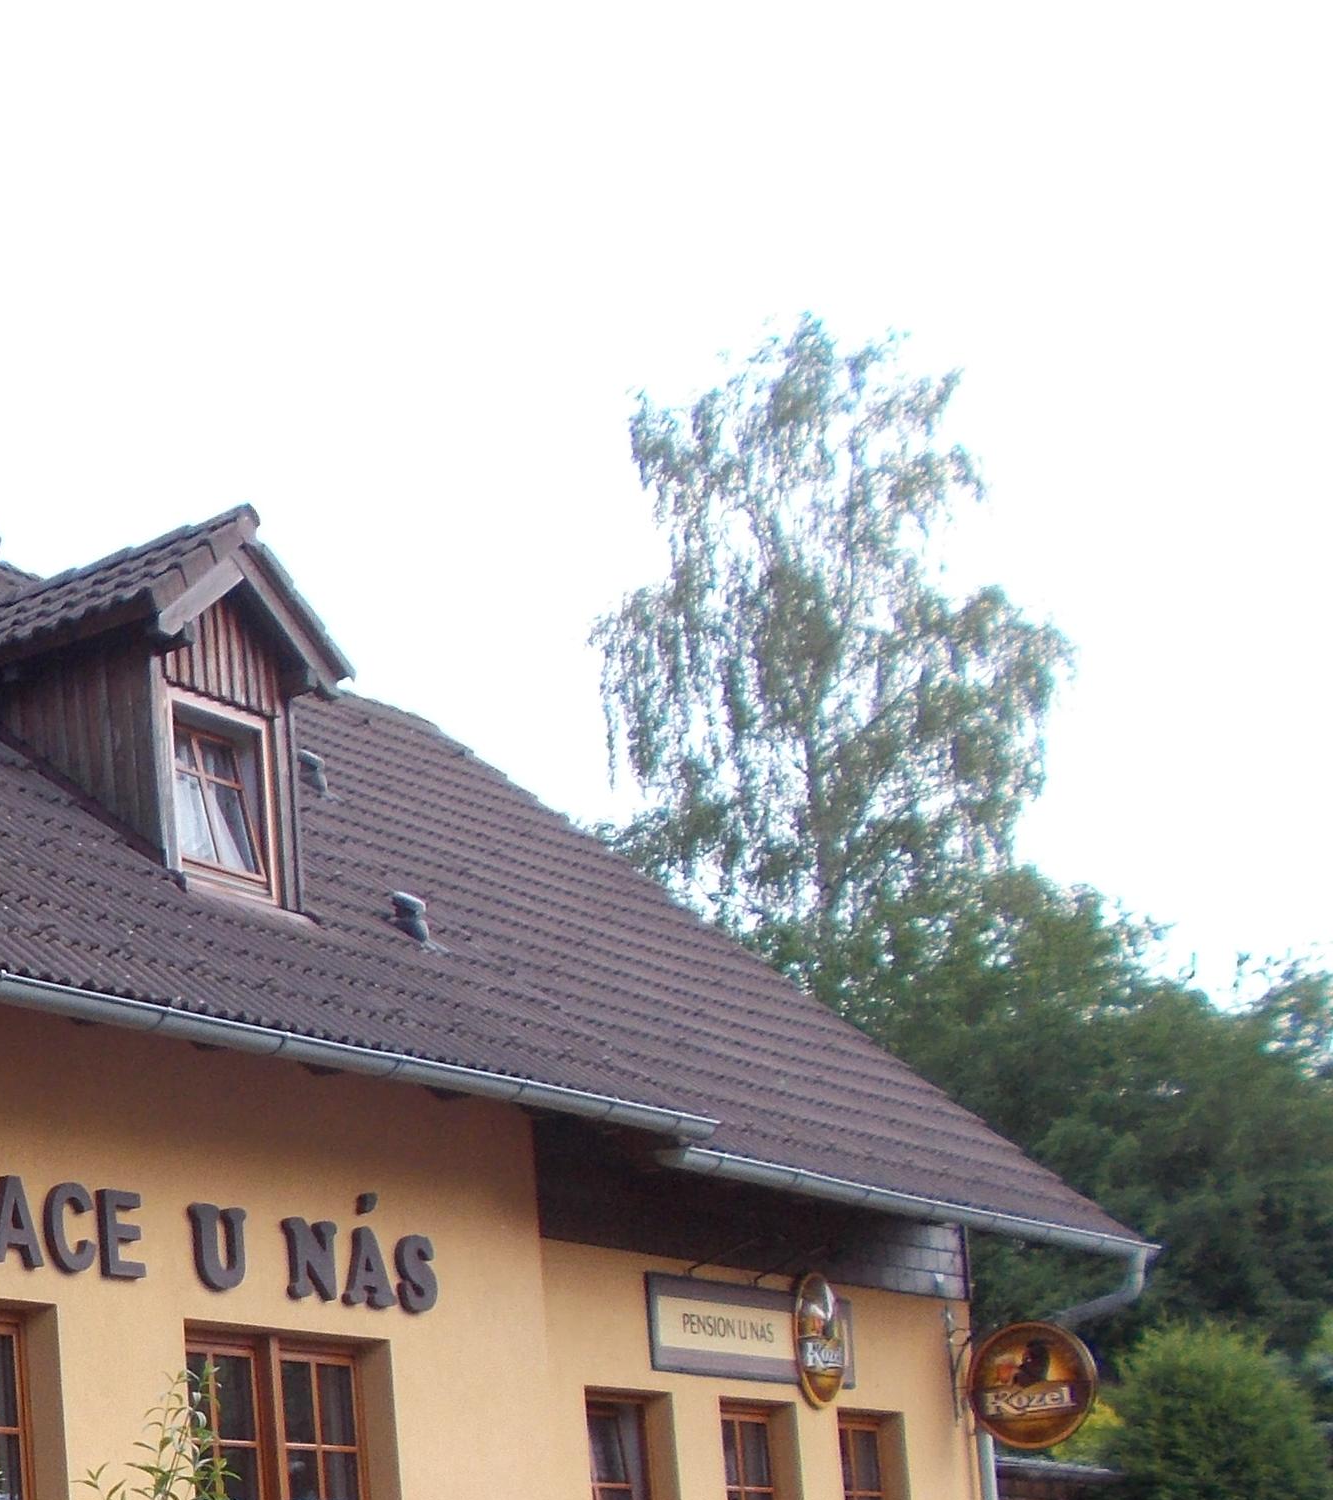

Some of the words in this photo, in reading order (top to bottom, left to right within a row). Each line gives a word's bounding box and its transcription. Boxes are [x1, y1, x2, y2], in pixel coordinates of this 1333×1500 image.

[187, 1202, 247, 1291] U
[280, 1192, 439, 1315] NÁS
[683, 1312, 736, 1339] PENSION
[738, 1318, 748, 1341] U
[984, 1386, 1077, 1416] Kozel
